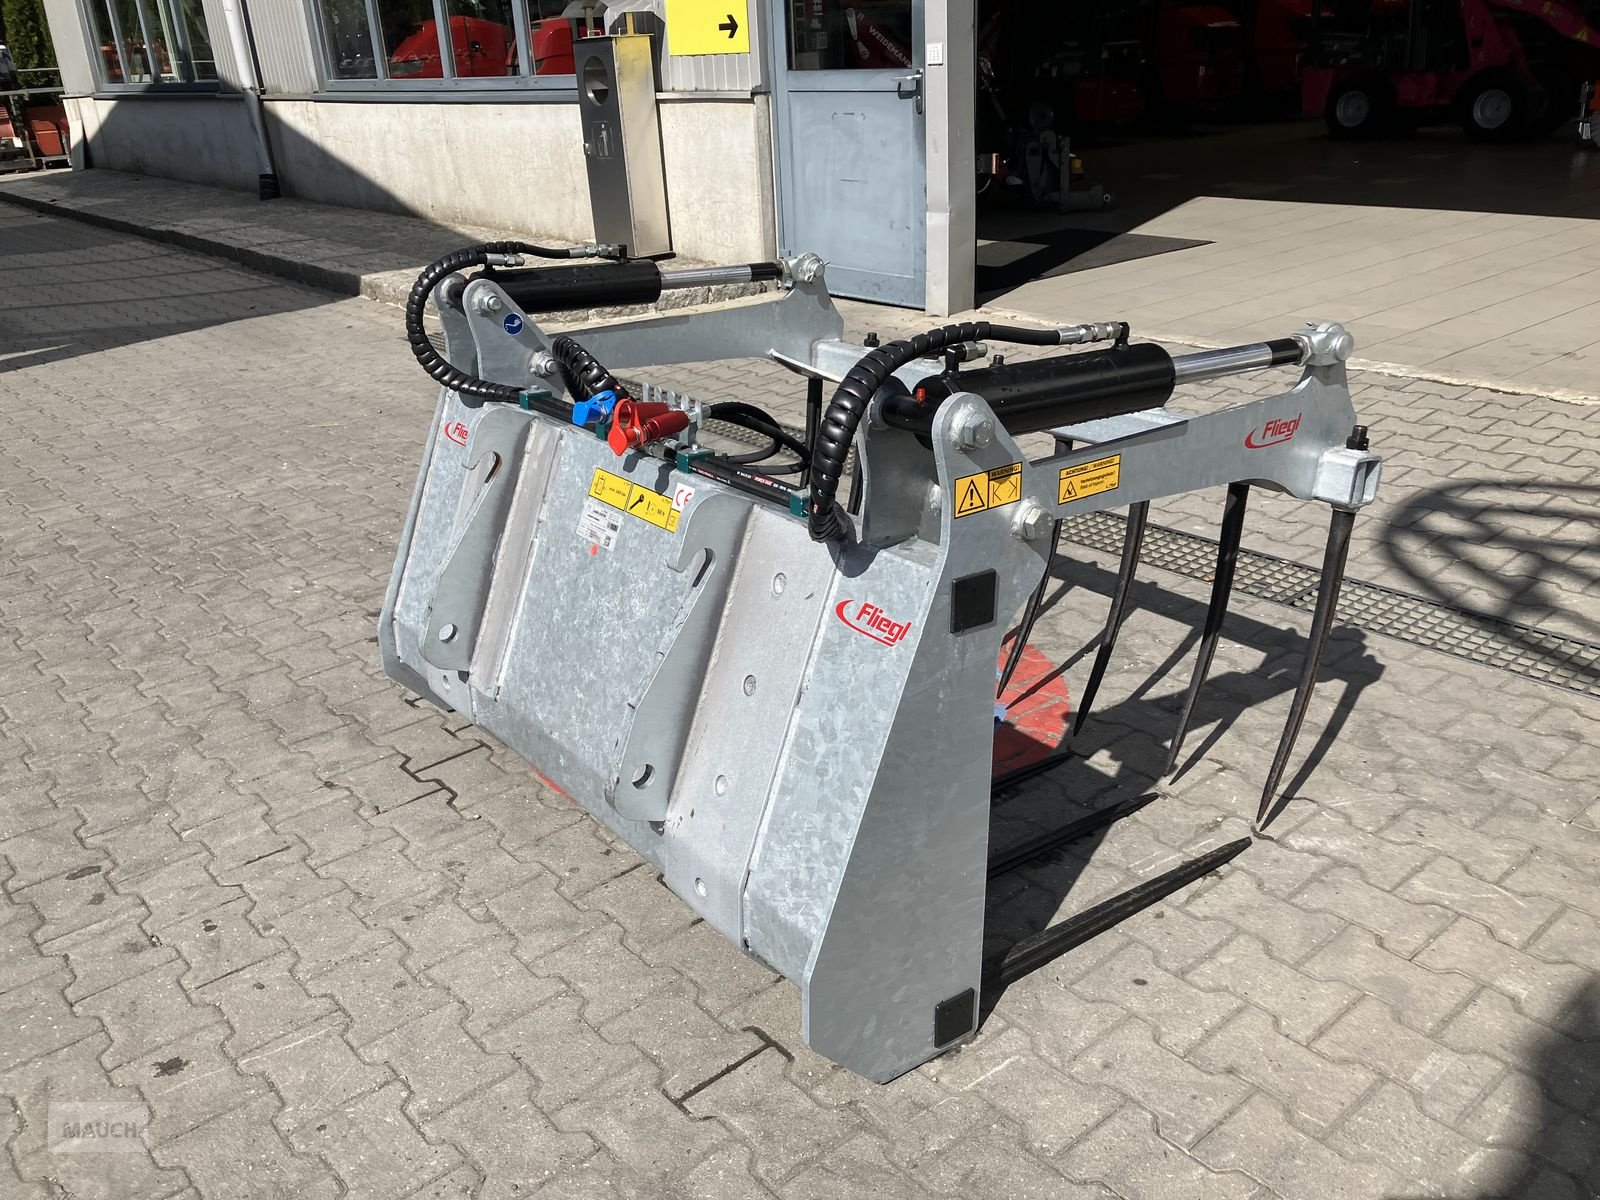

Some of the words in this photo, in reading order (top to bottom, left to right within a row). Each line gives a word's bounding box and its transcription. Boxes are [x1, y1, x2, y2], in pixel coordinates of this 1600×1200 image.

[1261, 412, 1303, 440] Fliegl
[991, 465, 1020, 477] WARNING!
[855, 602, 912, 643] Fliegl
